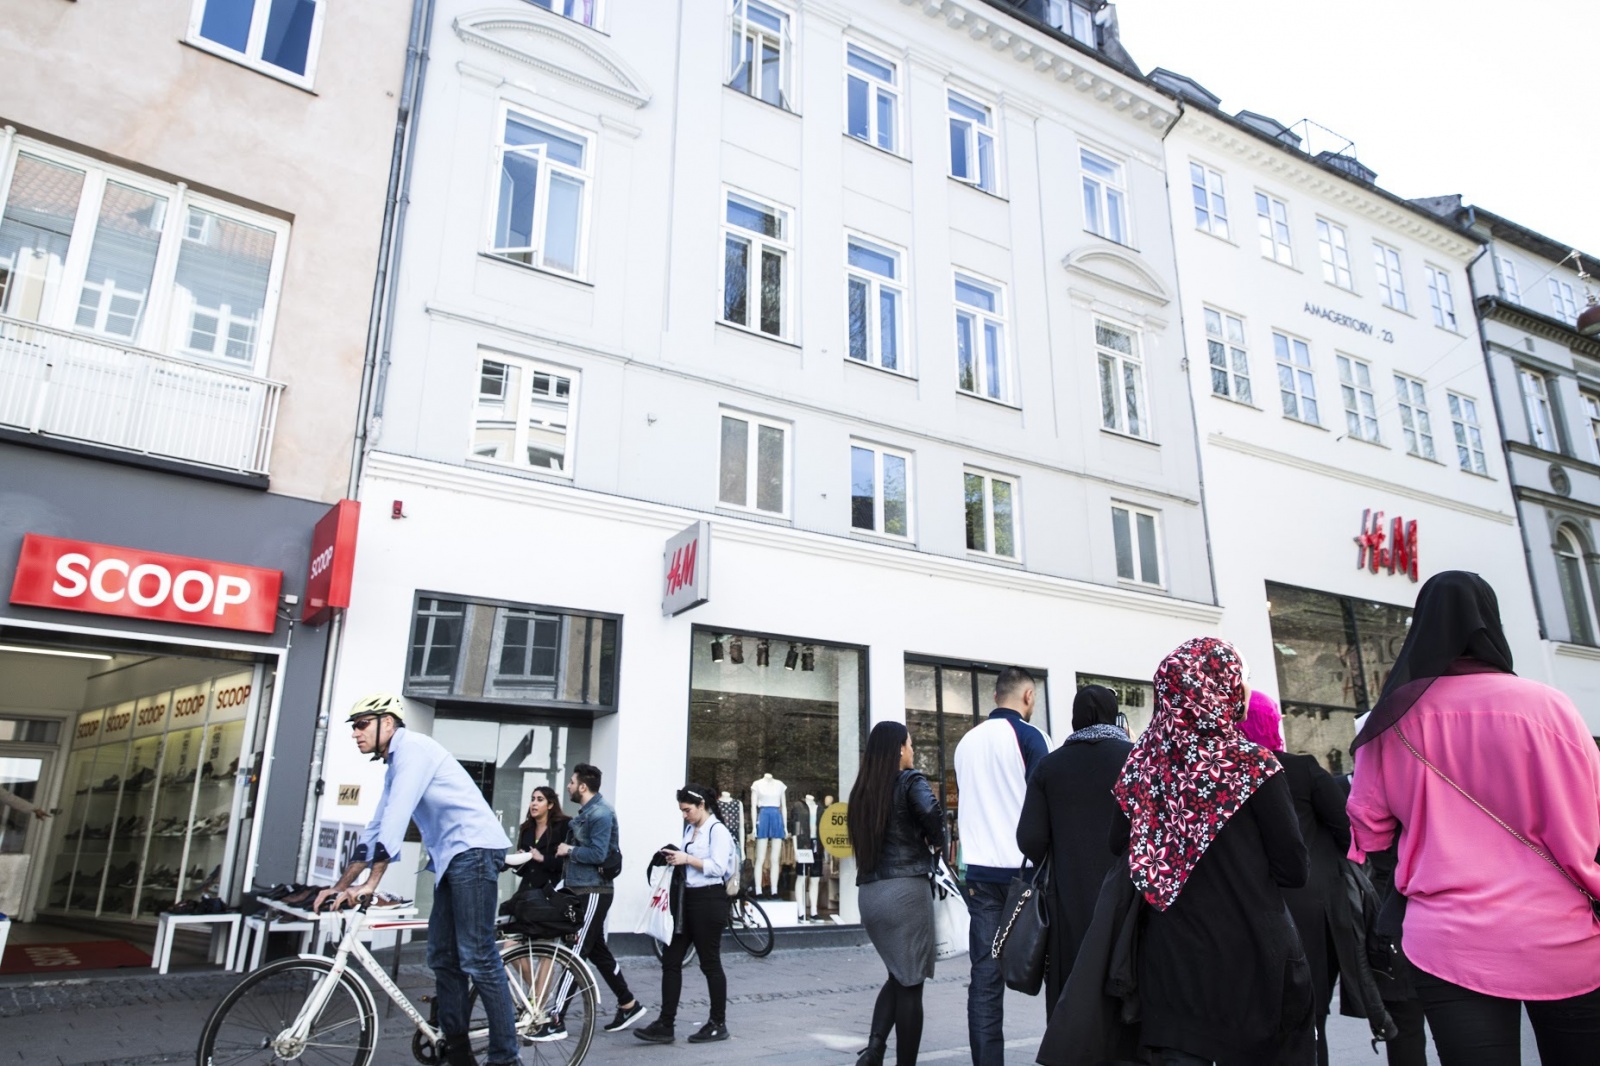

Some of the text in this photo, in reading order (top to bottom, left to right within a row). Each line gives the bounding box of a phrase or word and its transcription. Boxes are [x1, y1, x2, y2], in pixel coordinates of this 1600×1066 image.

[1304, 301, 1373, 336] AMAGERTORV
[1353, 508, 1418, 583] H&M
[310, 545, 333, 580] SCOOP
[666, 538, 697, 596] H&M
[52, 553, 251, 616] SCOOP
[174, 694, 205, 718] SCOOP
[216, 685, 251, 709] SCOOP
[77, 720, 99, 739] SCOOP
[105, 712, 130, 733] SCOOP
[138, 704, 165, 726] SCOOP
[826, 836, 852, 846] OVERT
[368, 961, 424, 1025] CENTURION
